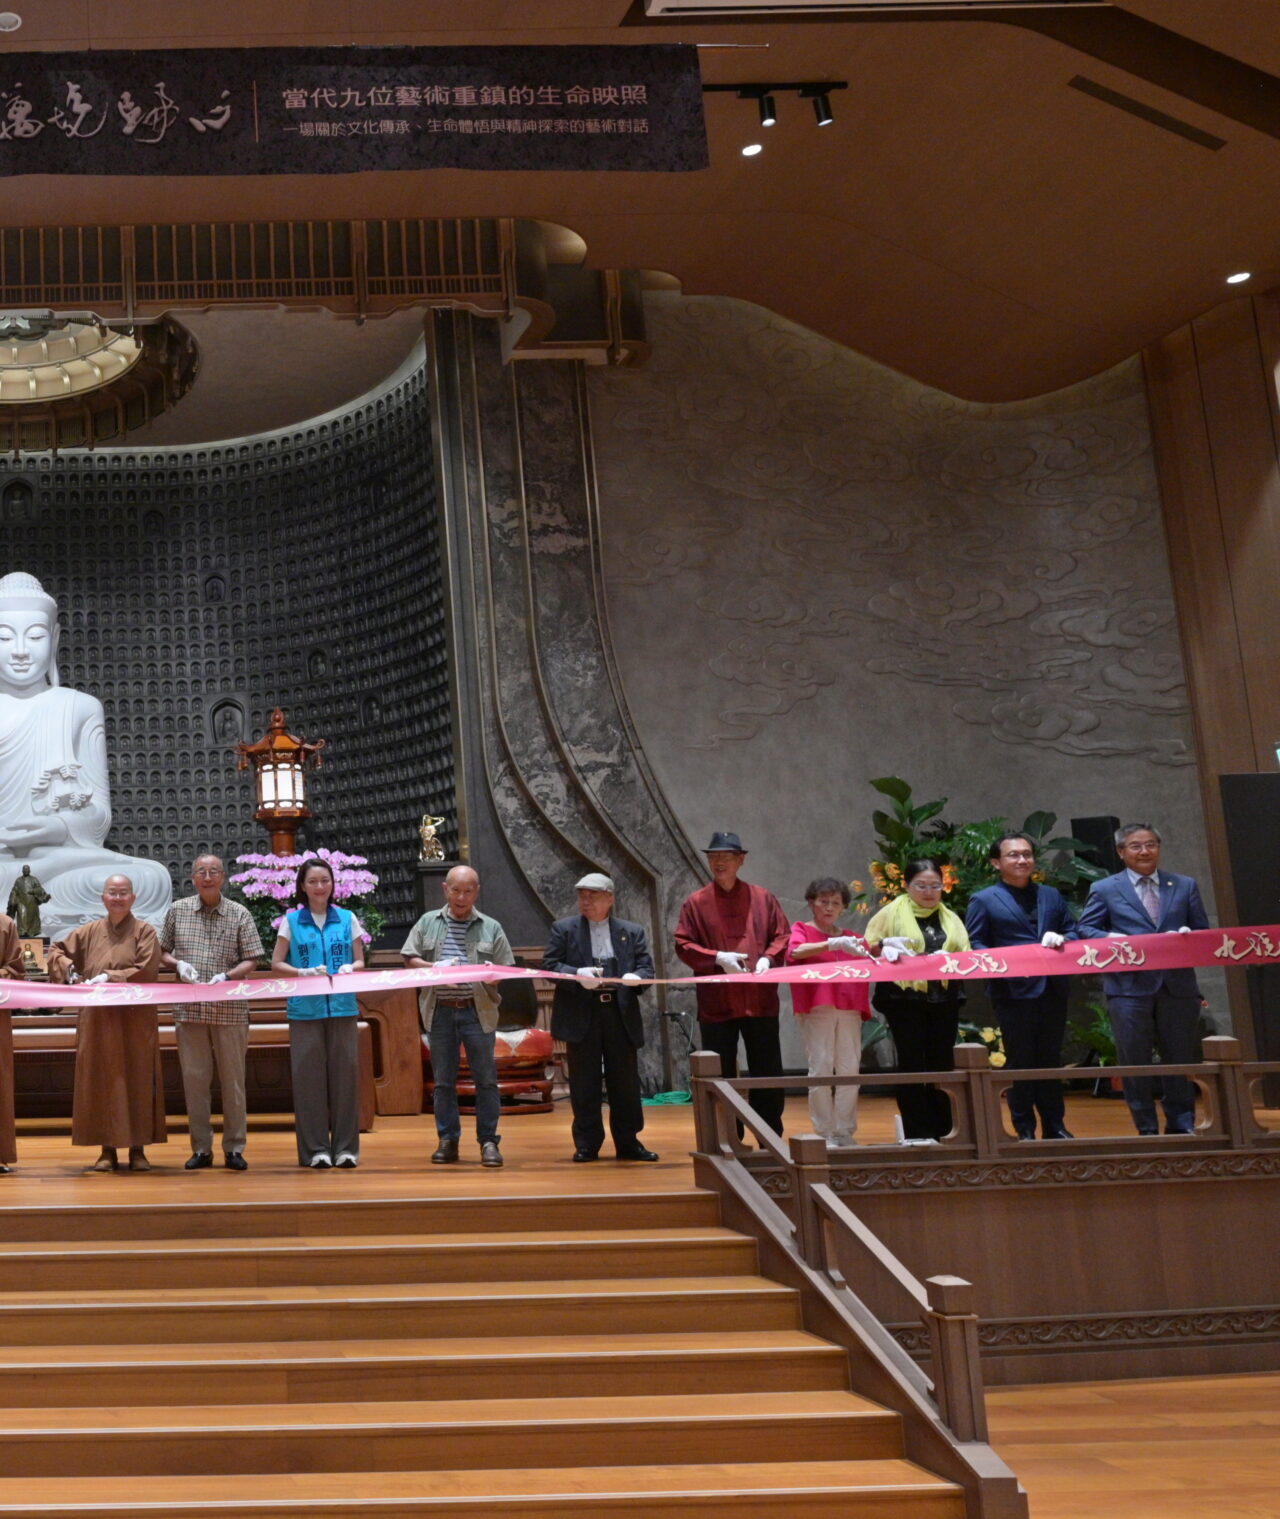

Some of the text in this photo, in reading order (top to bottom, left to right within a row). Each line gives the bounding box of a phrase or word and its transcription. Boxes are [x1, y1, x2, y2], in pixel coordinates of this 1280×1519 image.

[282, 84, 649, 109] 當代九位藝術重鎮的生命映照
